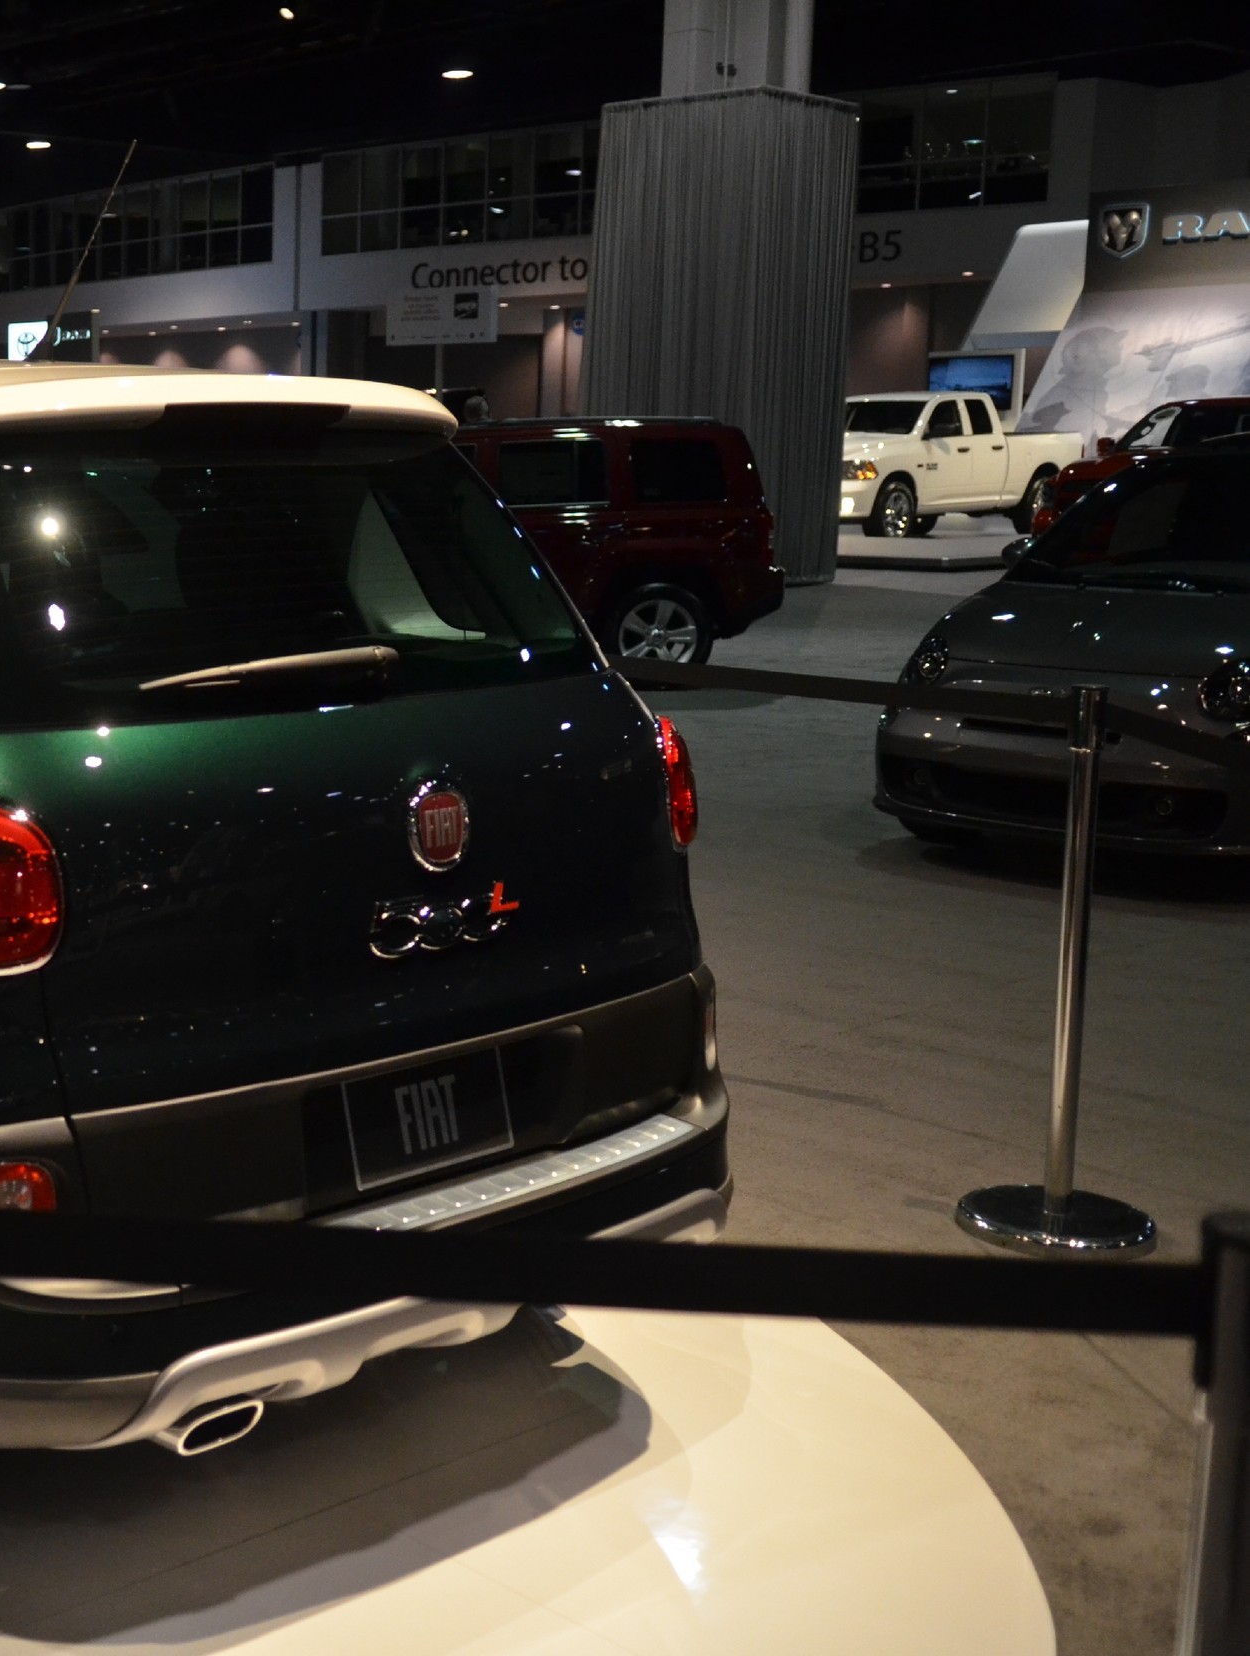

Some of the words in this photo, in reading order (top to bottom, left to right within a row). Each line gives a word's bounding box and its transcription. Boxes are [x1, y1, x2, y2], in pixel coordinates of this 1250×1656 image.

[1161, 211, 1250, 241] RA
[411, 258, 552, 289] Connector
[559, 256, 589, 281] to
[857, 229, 902, 263] B5
[424, 806, 461, 849] FIAT
[394, 1073, 460, 1155] FIAT
